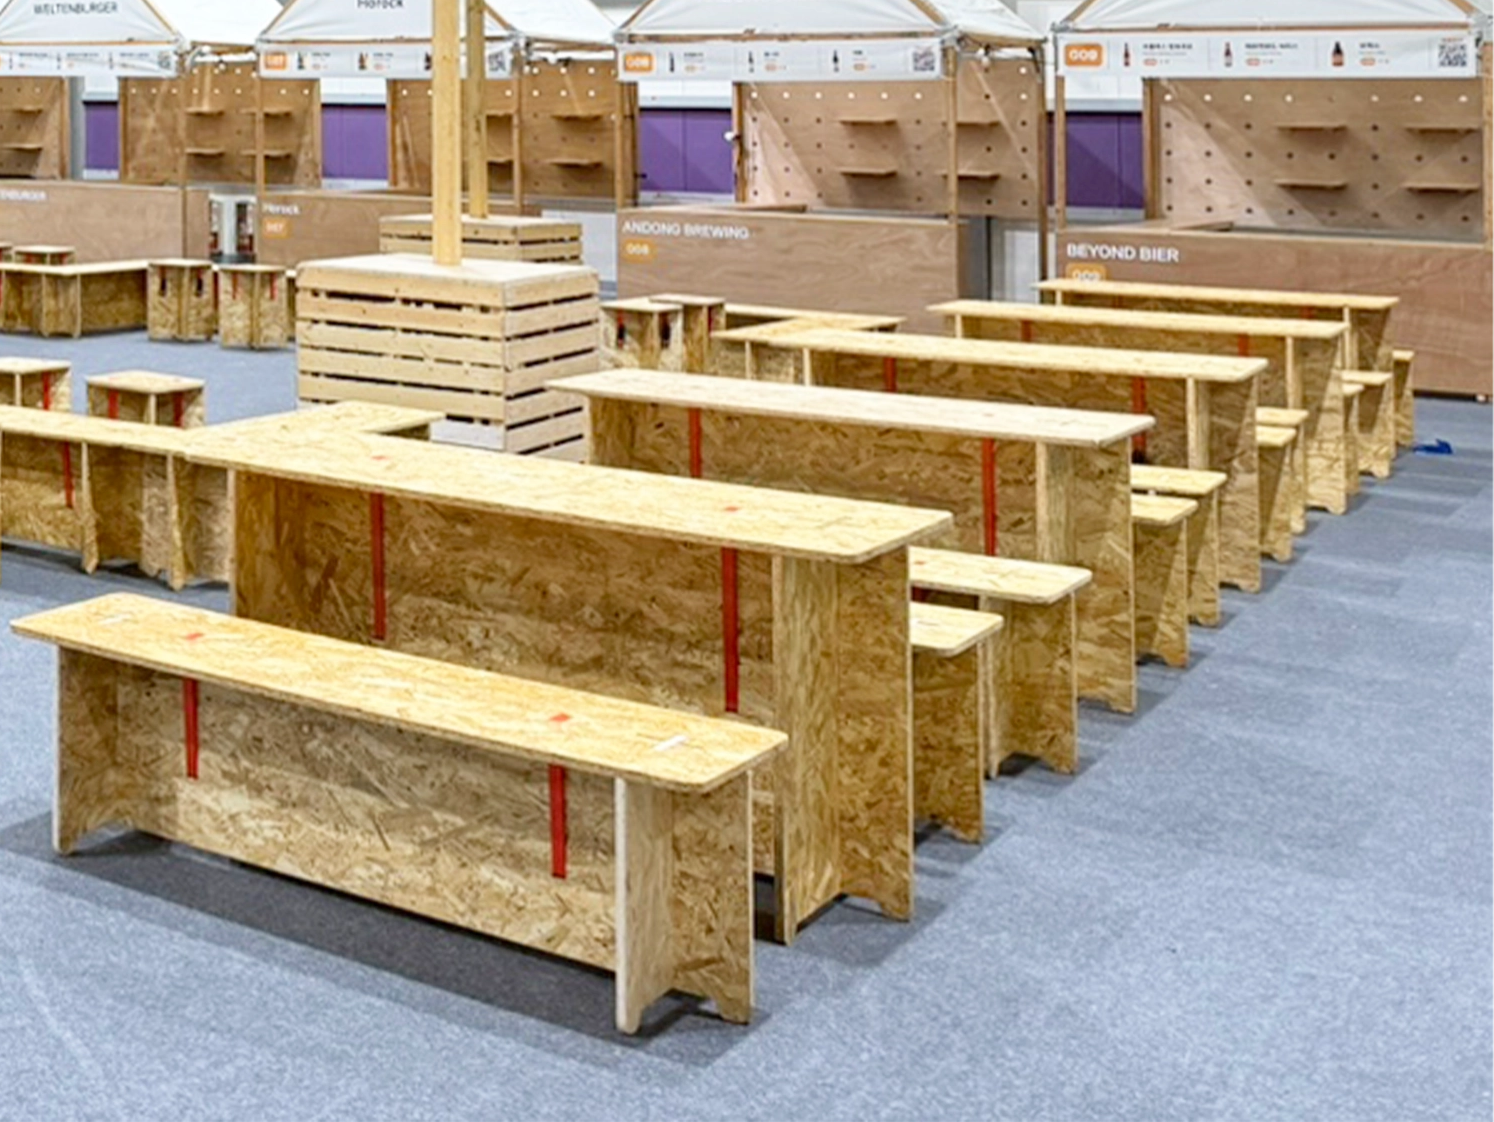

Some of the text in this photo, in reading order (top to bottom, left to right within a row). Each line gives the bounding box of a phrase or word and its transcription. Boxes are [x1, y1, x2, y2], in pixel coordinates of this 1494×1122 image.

[33, 1, 118, 16] WELTENBURGER
[621, 221, 750, 240] ANDONG BREWING
[1066, 243, 1180, 263] BEYOND BIER
